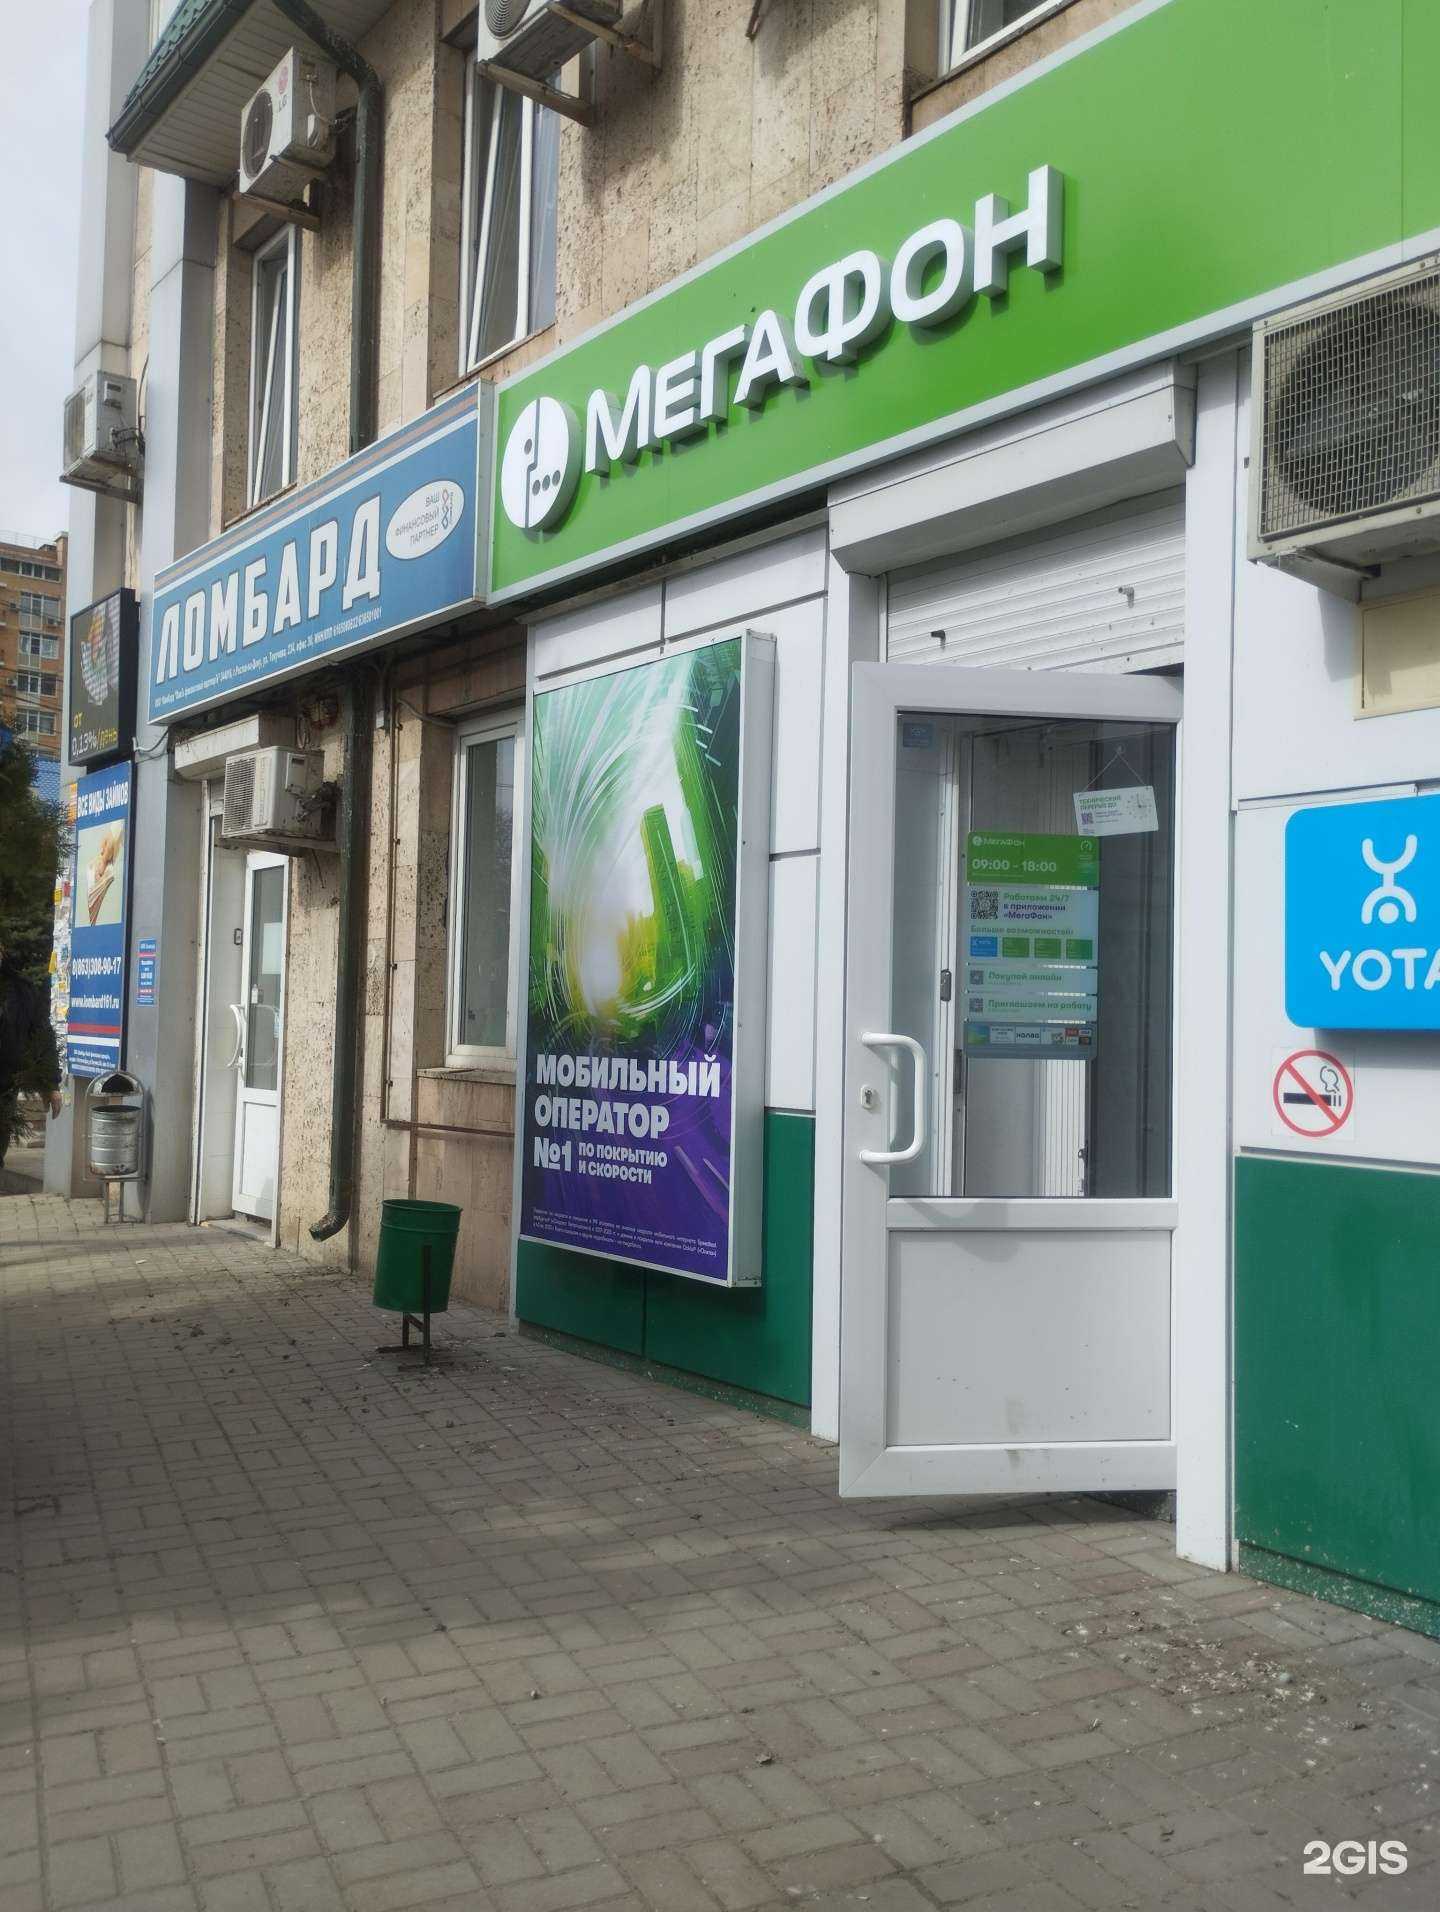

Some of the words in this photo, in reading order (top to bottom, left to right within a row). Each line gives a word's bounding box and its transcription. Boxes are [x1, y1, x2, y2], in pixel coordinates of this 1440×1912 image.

[410, 523, 439, 545] ПАРТНЕР
[156, 495, 382, 685] ЛОМБАРД
[78, 794, 89, 818] ВСЕ
[89, 789, 105, 816] ВИДЫ
[105, 780, 129, 810] ЗАЙМОВ
[972, 858, 1011, 871] 09:00
[1022, 860, 1057, 873] 18:00
[1003, 892, 1047, 902] Работаем
[1049, 893, 1070, 903] 24/7
[1010, 903, 1066, 912] приложении
[988, 998, 1046, 1009] Приглашаем
[1047, 1002, 1060, 1010] на
[1060, 1002, 1093, 1012] работу
[536, 1053, 721, 1098] МОБИЛЬНЫЙ
[534, 1094, 670, 1140] ОПЕРАТОР
[533, 1136, 572, 1173] №1
[578, 1142, 595, 1158] ПО
[596, 1143, 668, 1168] ПОКРЫТИЮ
[578, 1160, 587, 1175] И
[588, 1161, 652, 1185] СКОРОСТИ
